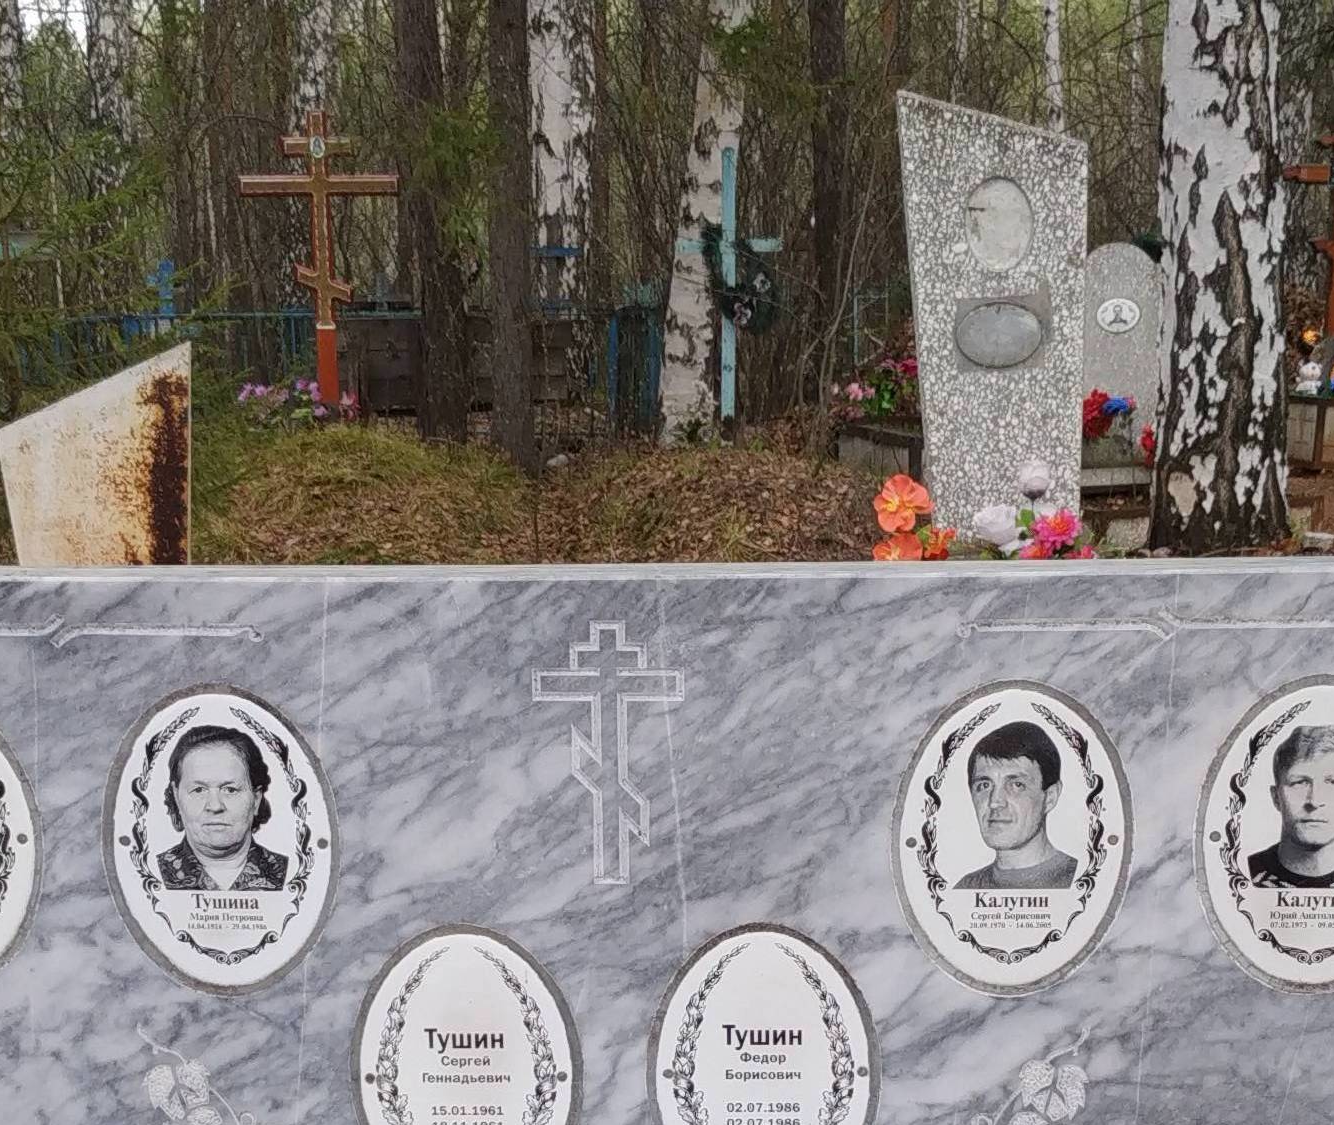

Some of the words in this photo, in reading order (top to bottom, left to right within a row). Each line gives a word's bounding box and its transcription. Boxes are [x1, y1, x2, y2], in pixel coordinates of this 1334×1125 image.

[191, 893, 259, 912] Тушина
[974, 892, 1049, 911] Калугин
[189, 912, 219, 922] Мария
[222, 912, 264, 922] Петровна
[971, 911, 1001, 921] Сергей
[1004, 911, 1051, 921] Борисович
[1269, 911, 1297, 921] Юрий
[423, 1028, 505, 1053] Тушин
[722, 1024, 803, 1050] Тушин
[441, 1055, 491, 1068] Сергей
[739, 1051, 787, 1065] Федор
[422, 1072, 511, 1085] Геннадьевич
[725, 1069, 801, 1081] Борисович
[431, 1105, 504, 1116] 15.01.1961
[726, 1102, 801, 1113] 02.07.1986
